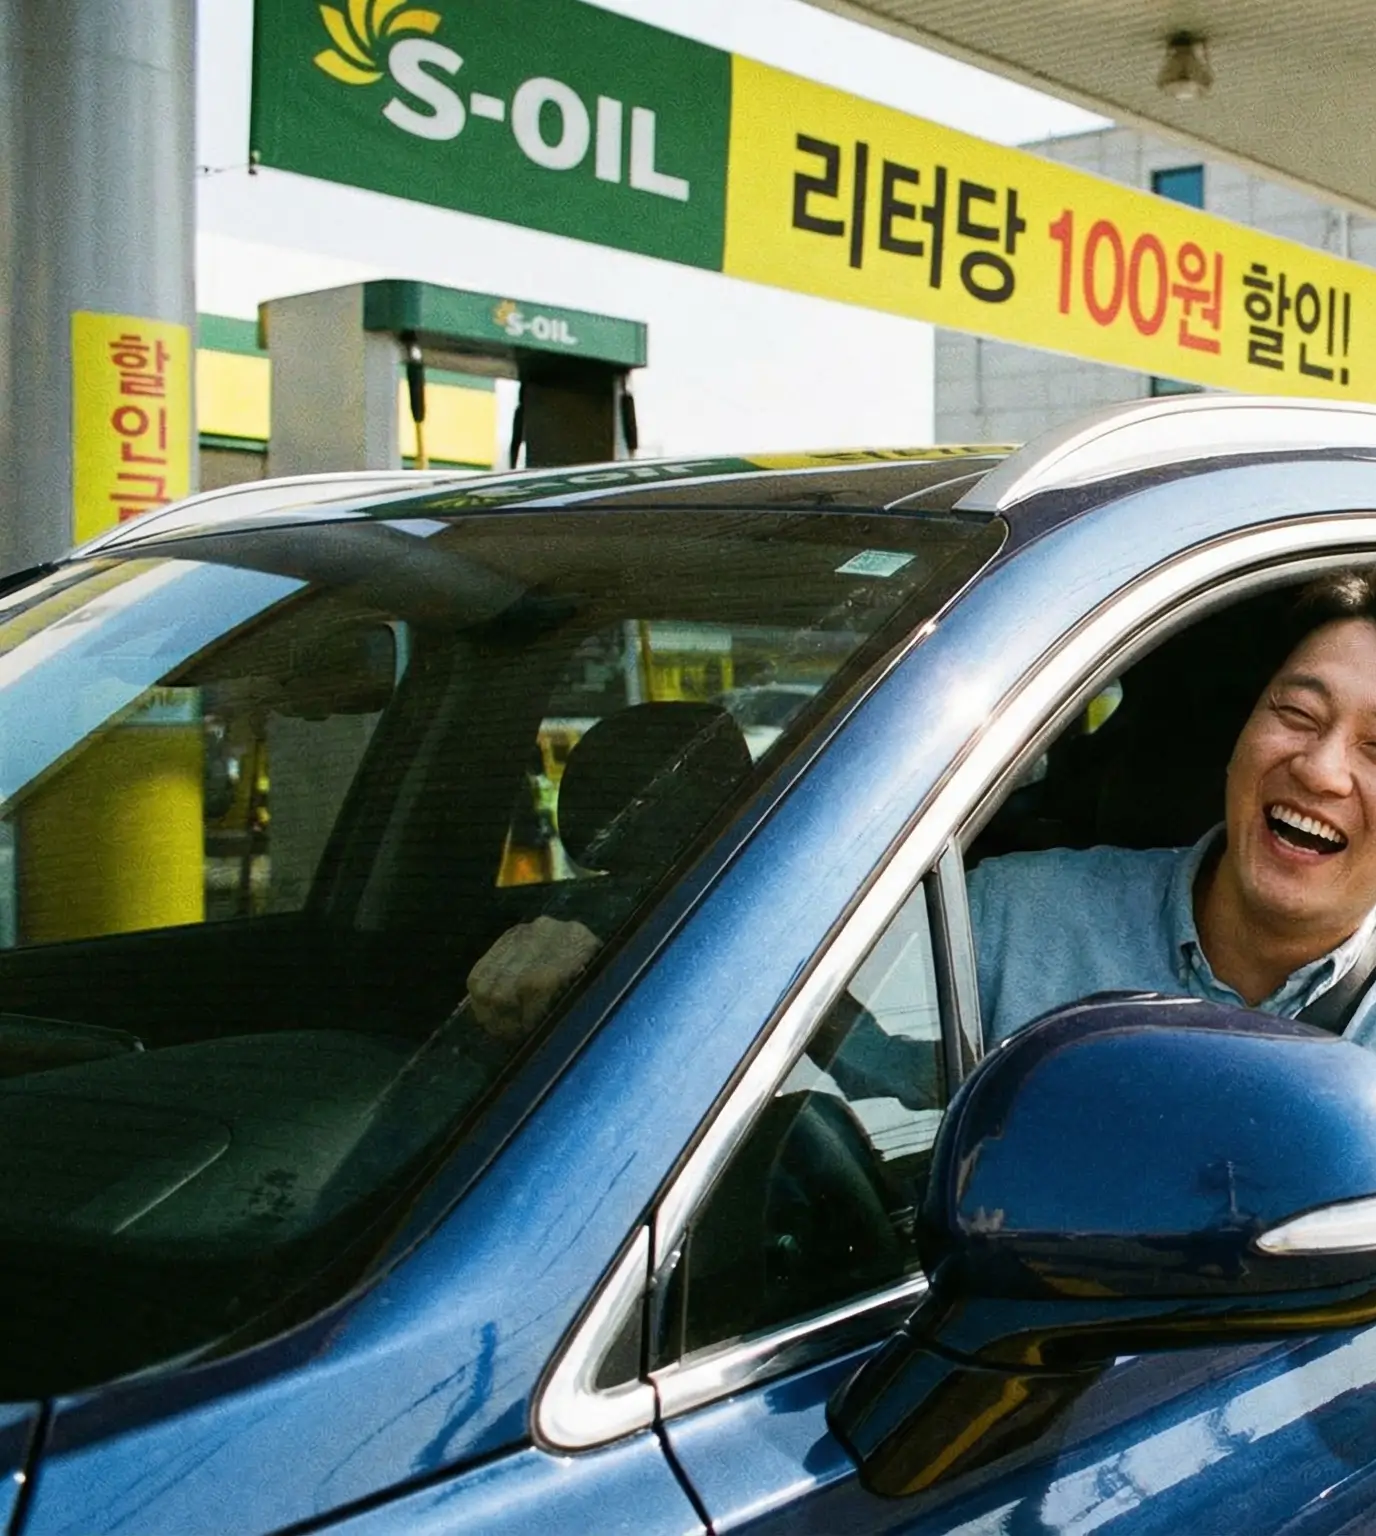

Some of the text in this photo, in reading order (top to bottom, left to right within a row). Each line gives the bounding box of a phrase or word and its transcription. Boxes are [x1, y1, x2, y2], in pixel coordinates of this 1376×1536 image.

[382, 38, 690, 202] S-OIL
[505, 312, 578, 345] S-OIL
[791, 132, 1352, 386] 리터당 100원 할인!
